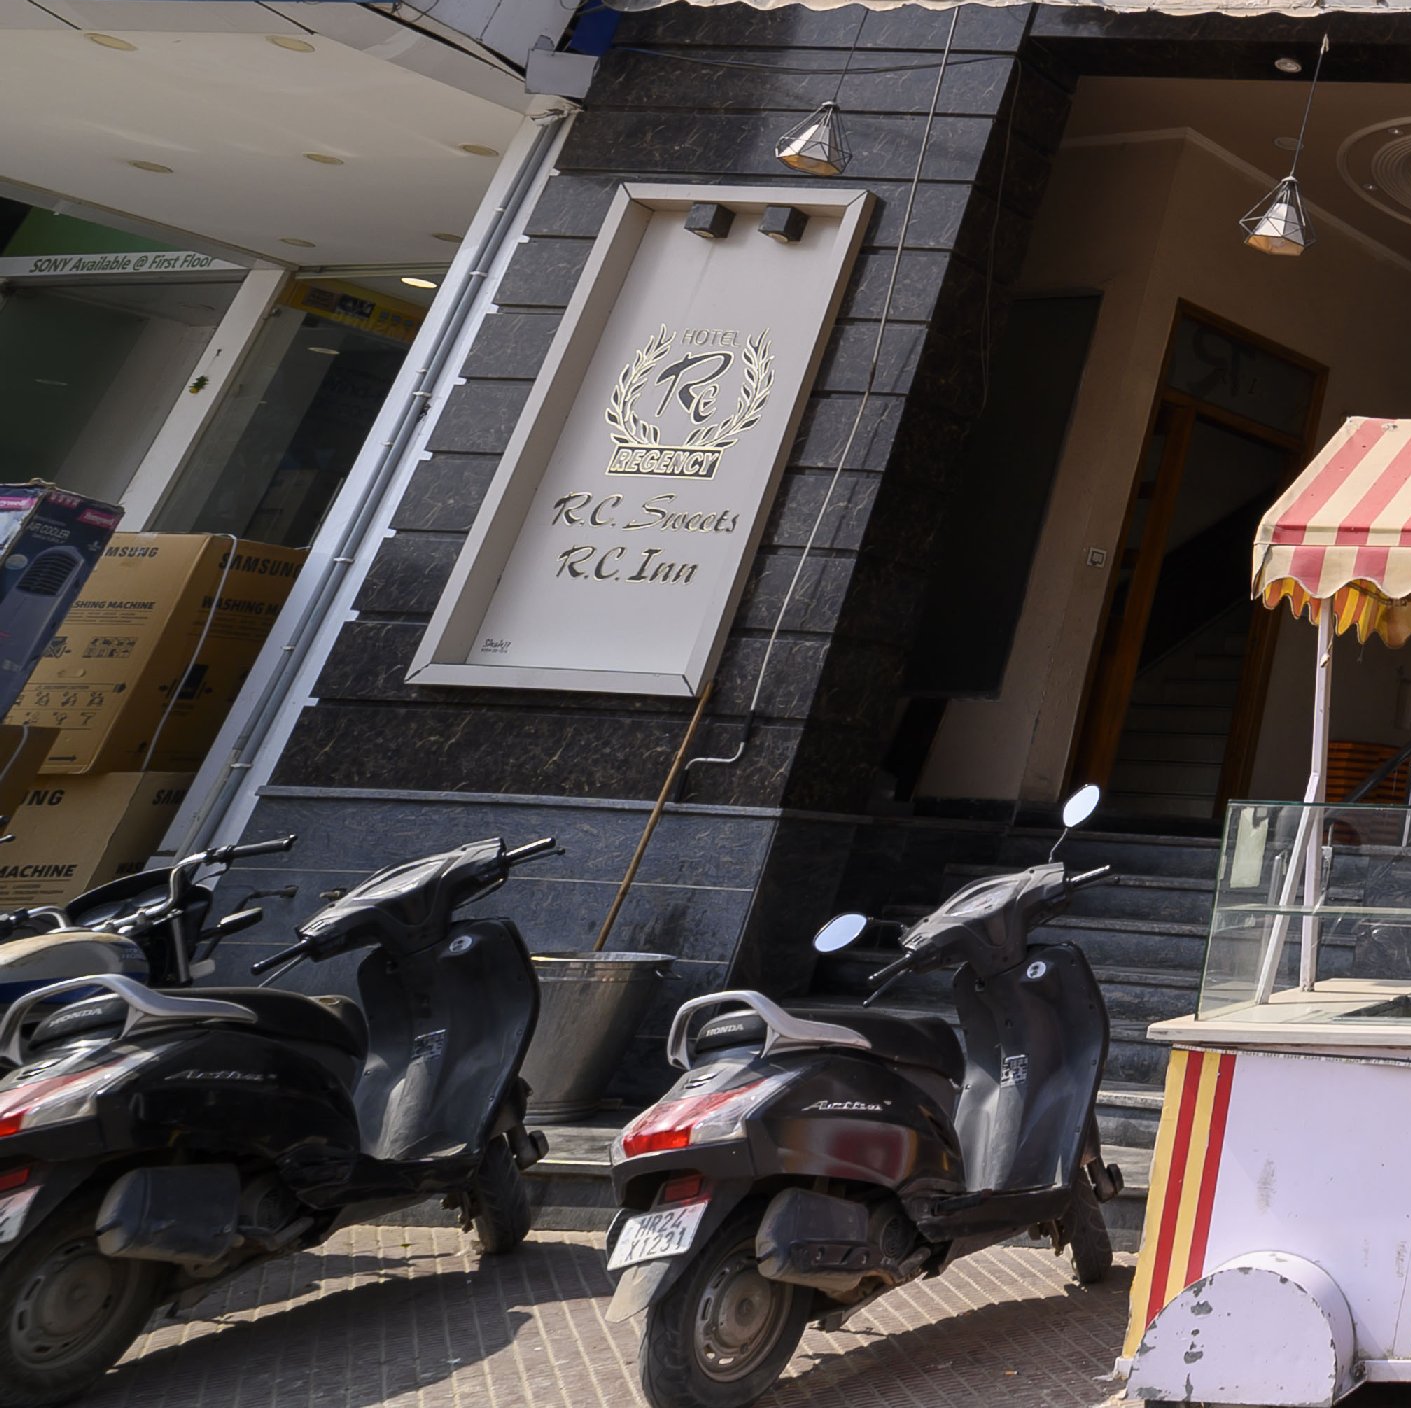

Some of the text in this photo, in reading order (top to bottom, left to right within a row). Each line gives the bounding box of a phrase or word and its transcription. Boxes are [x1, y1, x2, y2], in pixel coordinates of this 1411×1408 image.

[29, 254, 215, 274] SONY Available @ First Floor
[681, 328, 741, 347] HOTEL
[610, 448, 720, 476] REGENCY
[552, 491, 740, 534] R.C. Sweets
[104, 546, 159, 558] MSUNG
[556, 545, 699, 585] R.C. Inn
[74, 600, 156, 610] SHING MACHINE
[48, 1005, 103, 1029] HONDA
[706, 1022, 744, 1037] HONDA
[639, 1212, 683, 1238] HR24
